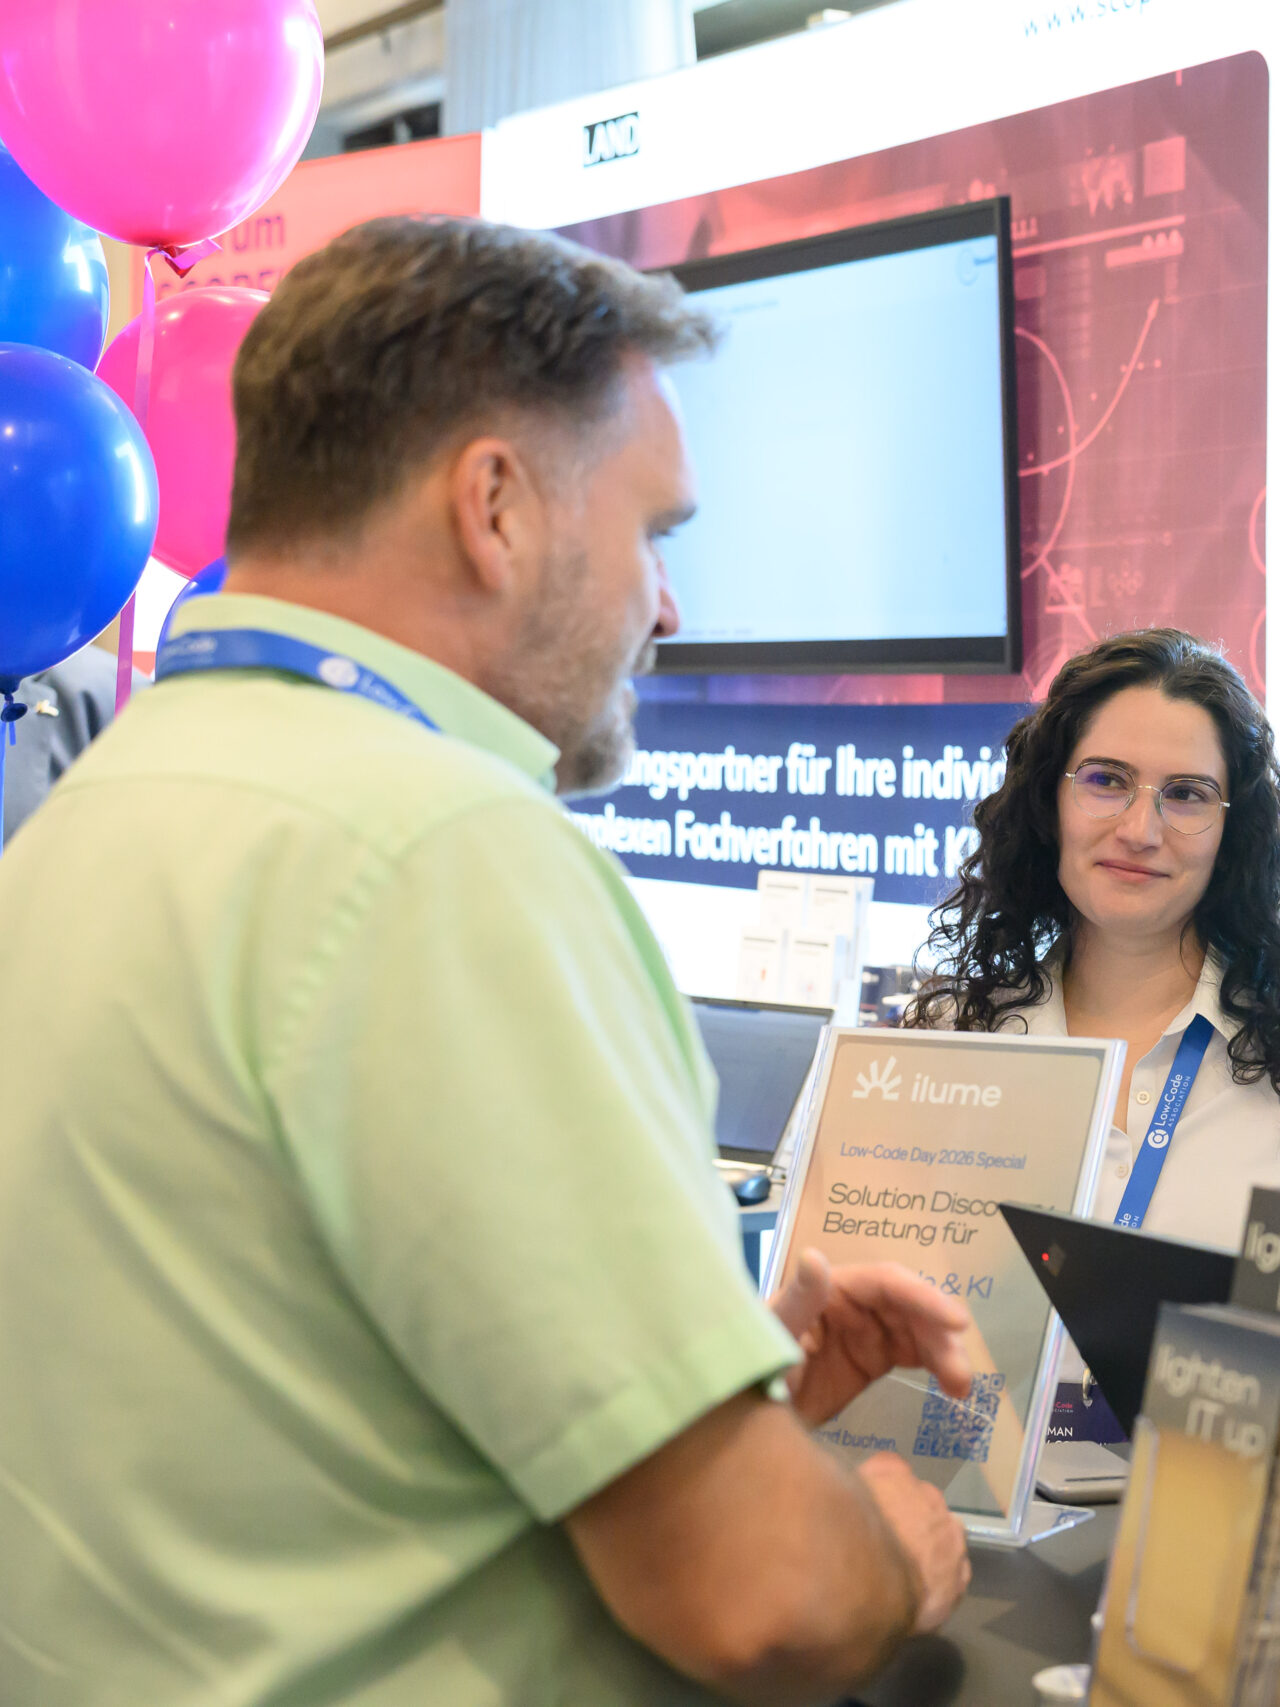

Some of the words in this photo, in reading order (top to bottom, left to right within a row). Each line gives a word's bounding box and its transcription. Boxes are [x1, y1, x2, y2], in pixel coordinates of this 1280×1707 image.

[583, 111, 640, 167] LAND
[788, 742, 833, 796] für
[836, 744, 898, 800] Ihre
[674, 809, 879, 874] Fachverfahren
[884, 822, 940, 877] mit
[911, 1072, 1002, 1107] ilume
[1154, 1074, 1184, 1126] Low-Code
[1168, 1075, 1191, 1127] ASSOCIATION
[840, 1142, 908, 1162] Low-Code
[910, 1146, 936, 1167] Day
[938, 1149, 975, 1166] 2026
[976, 1151, 1028, 1171] Special
[828, 1183, 926, 1211] Solution
[930, 1191, 1042, 1218] Disco
[822, 1211, 938, 1247] Beratung
[942, 1221, 979, 1246] für
[940, 1272, 962, 1297] &
[966, 1274, 995, 1300] KI
[1154, 1342, 1261, 1410] lighten
